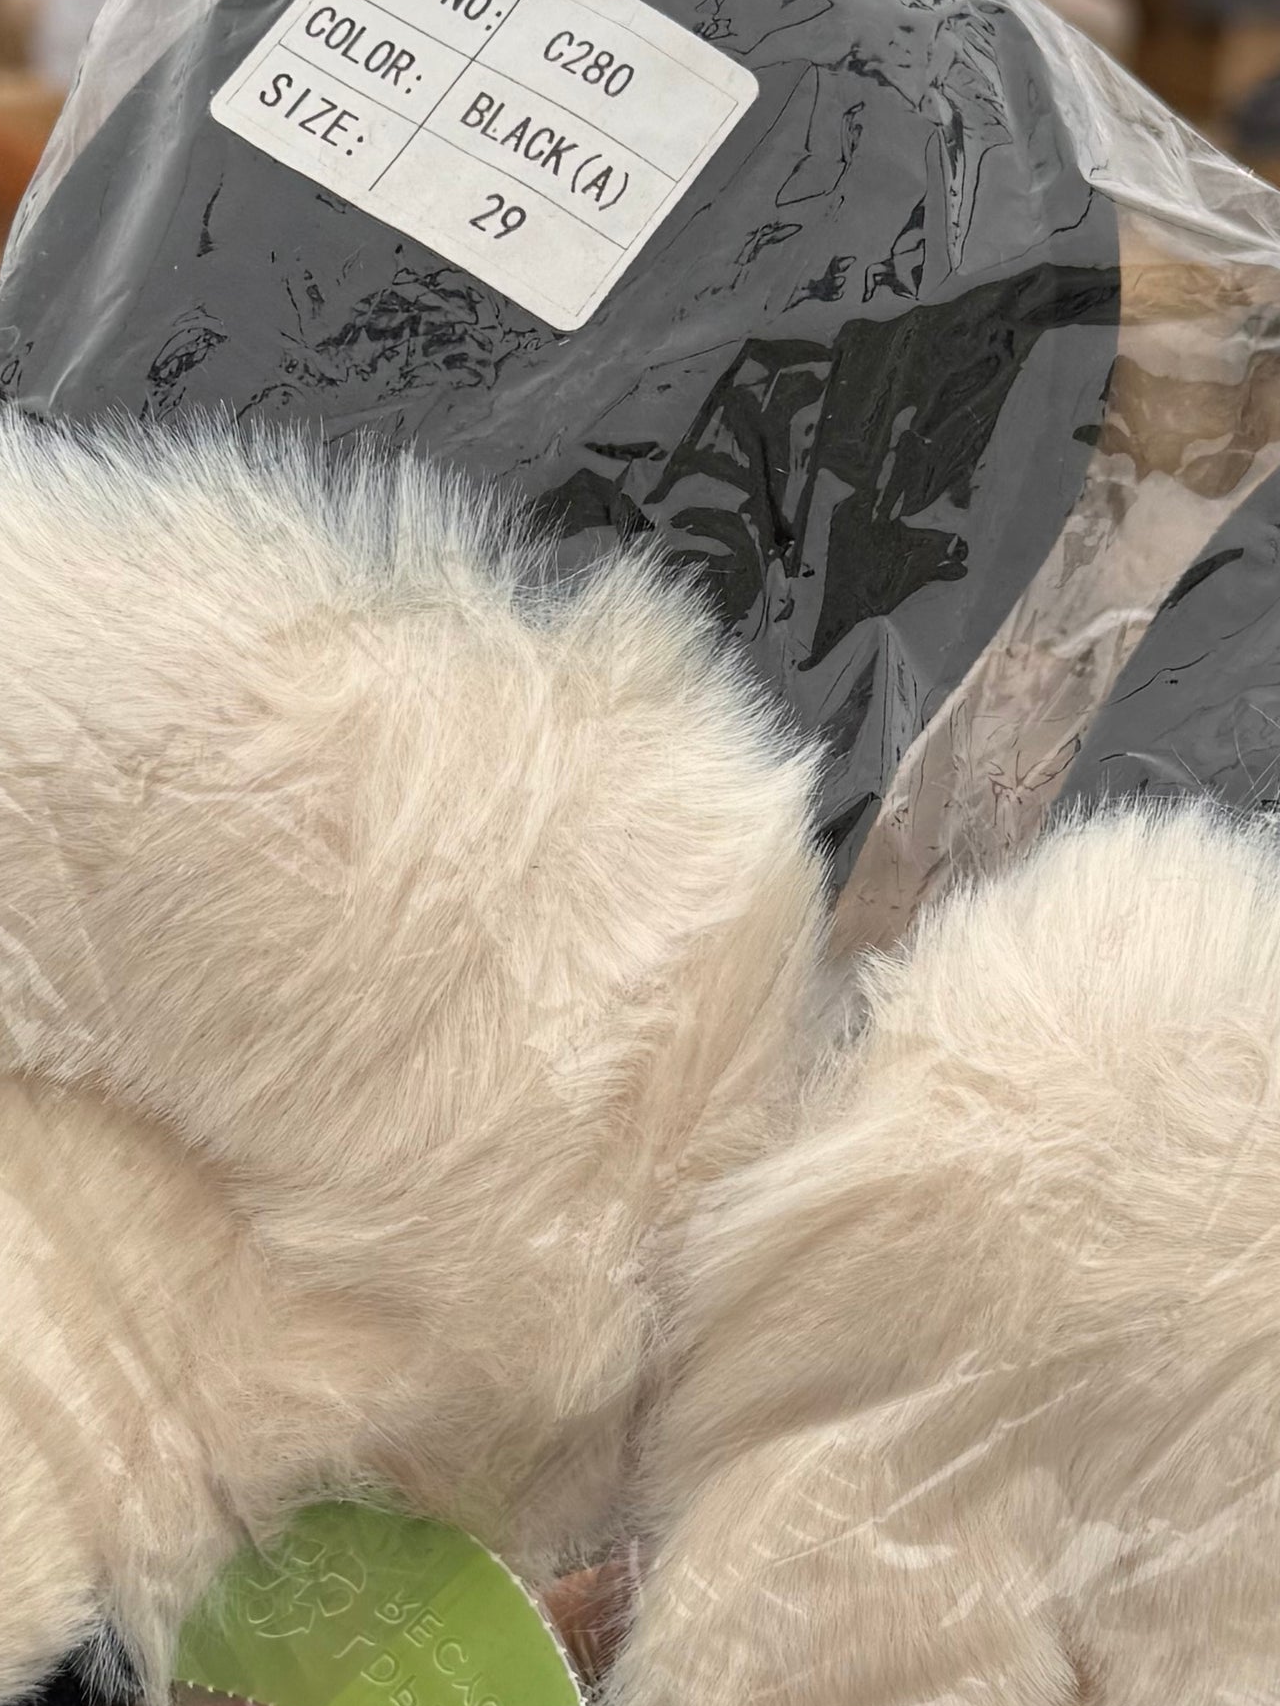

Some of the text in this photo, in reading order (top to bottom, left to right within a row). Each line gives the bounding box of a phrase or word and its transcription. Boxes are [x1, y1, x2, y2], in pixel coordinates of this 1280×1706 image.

[305, 6, 630, 212] COLOR: BLACK(A)
[543, 30, 635, 98] C280
[258, 73, 527, 240] SIZE: 29
